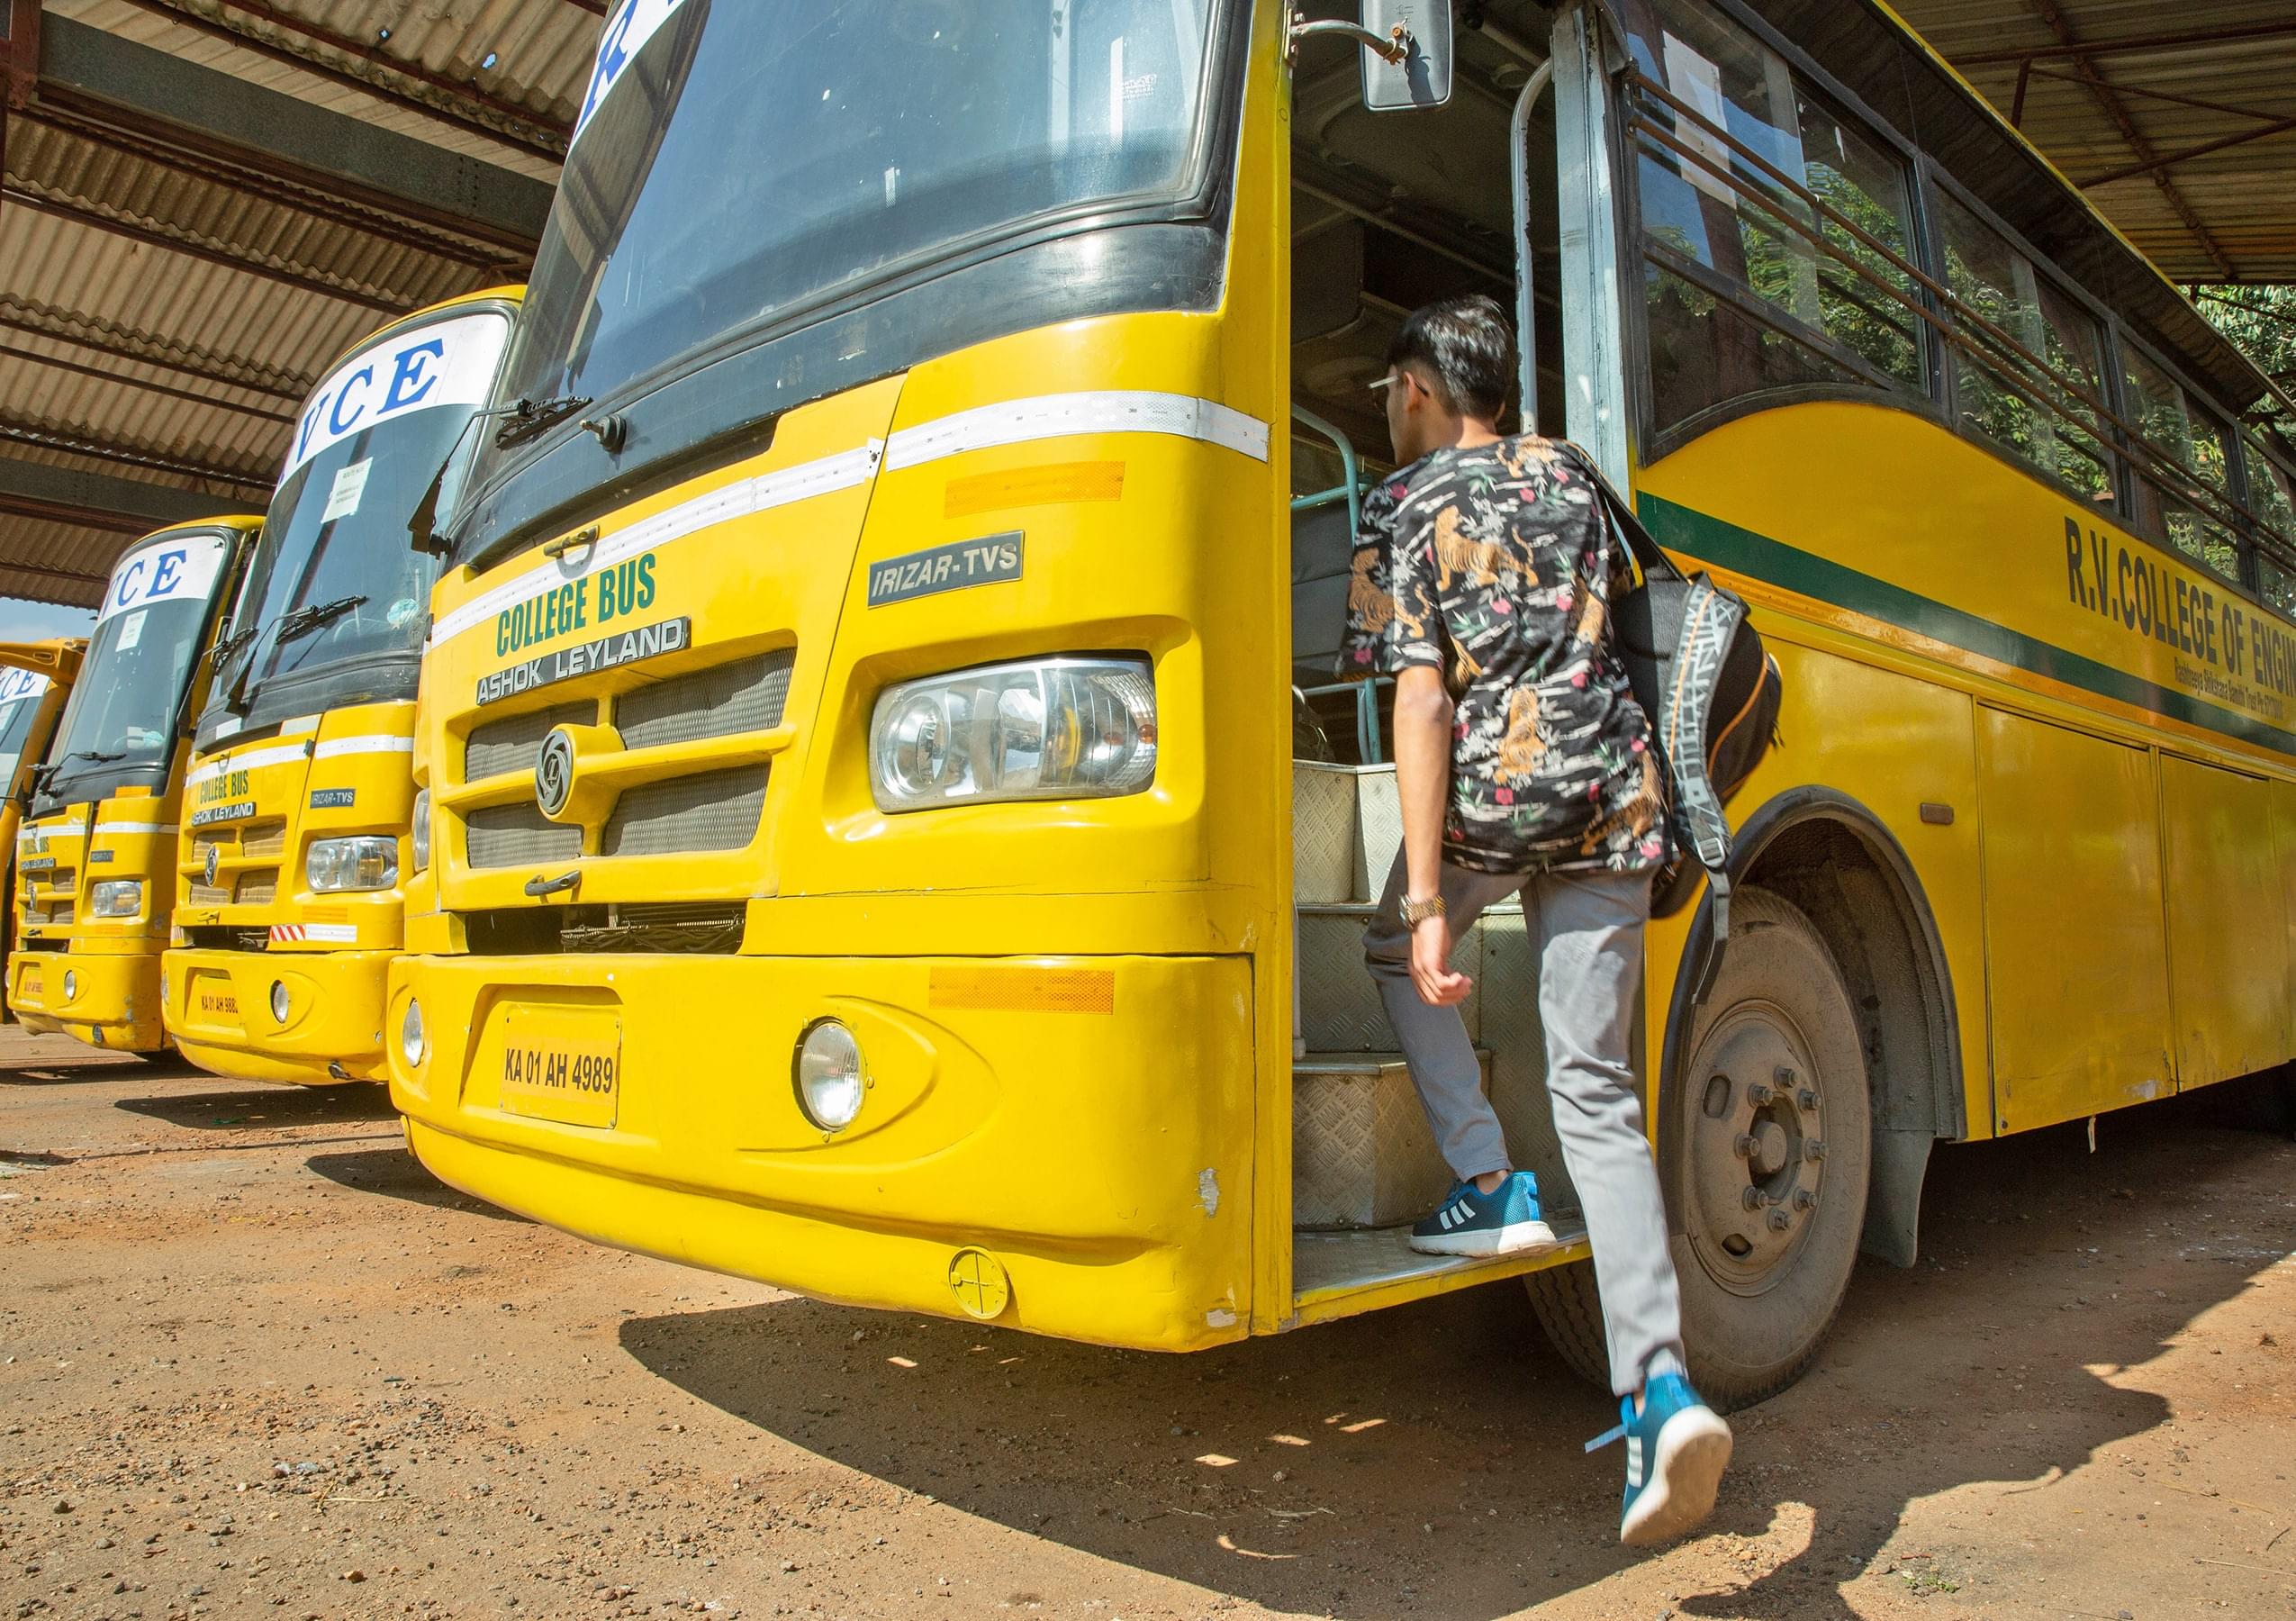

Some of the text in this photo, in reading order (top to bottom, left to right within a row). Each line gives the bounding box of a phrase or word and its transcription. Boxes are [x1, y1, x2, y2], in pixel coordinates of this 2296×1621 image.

[872, 543, 1017, 598] IRIZAR-TVS
[497, 553, 655, 657] COLLEGE BUS
[477, 618, 685, 705] ASHOK LEYLAND
[2222, 603, 2243, 677] OF
[200, 769, 249, 804] COLLEGE BUS
[214, 802, 254, 820] LEYLAND
[505, 1048, 613, 1094] KA 01 AH 4989
